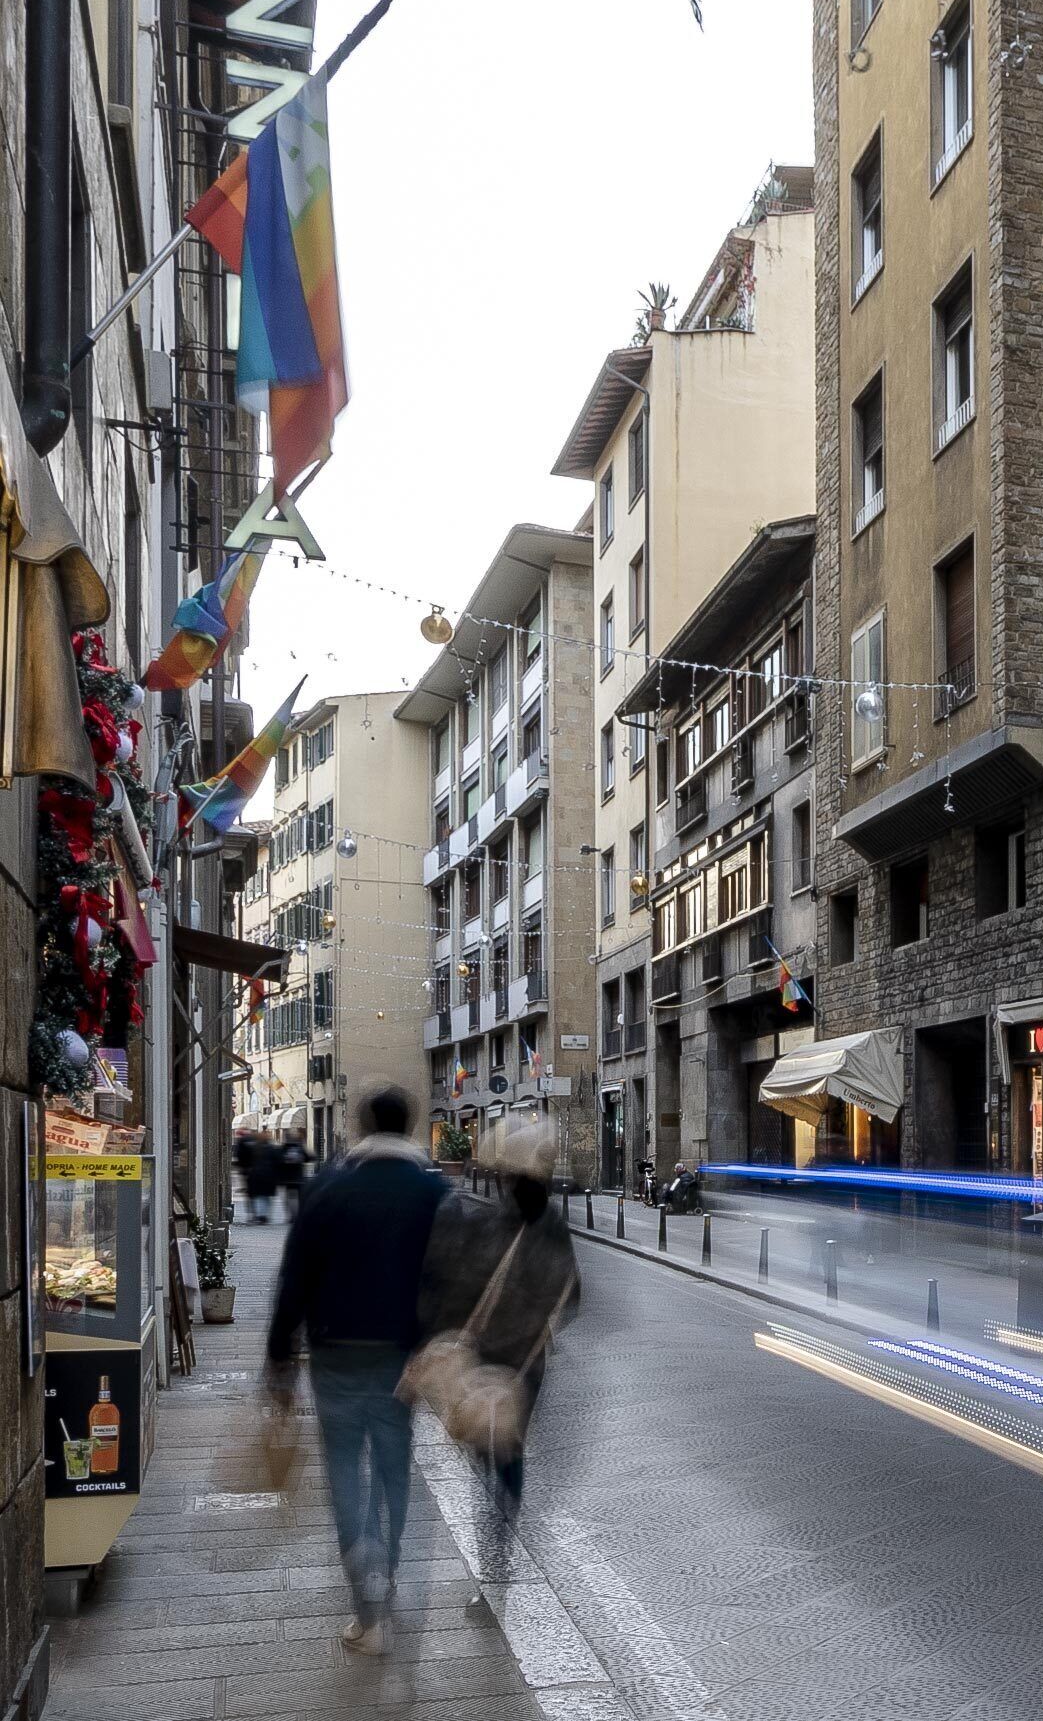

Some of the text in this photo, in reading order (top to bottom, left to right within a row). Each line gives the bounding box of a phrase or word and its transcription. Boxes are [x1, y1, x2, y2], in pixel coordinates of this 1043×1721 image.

[1029, 1030, 1036, 1053] I
[843, 1088, 876, 1110] Umberto
[82, 1163, 108, 1171] HOME
[75, 1482, 126, 1492] COCKTAILS
